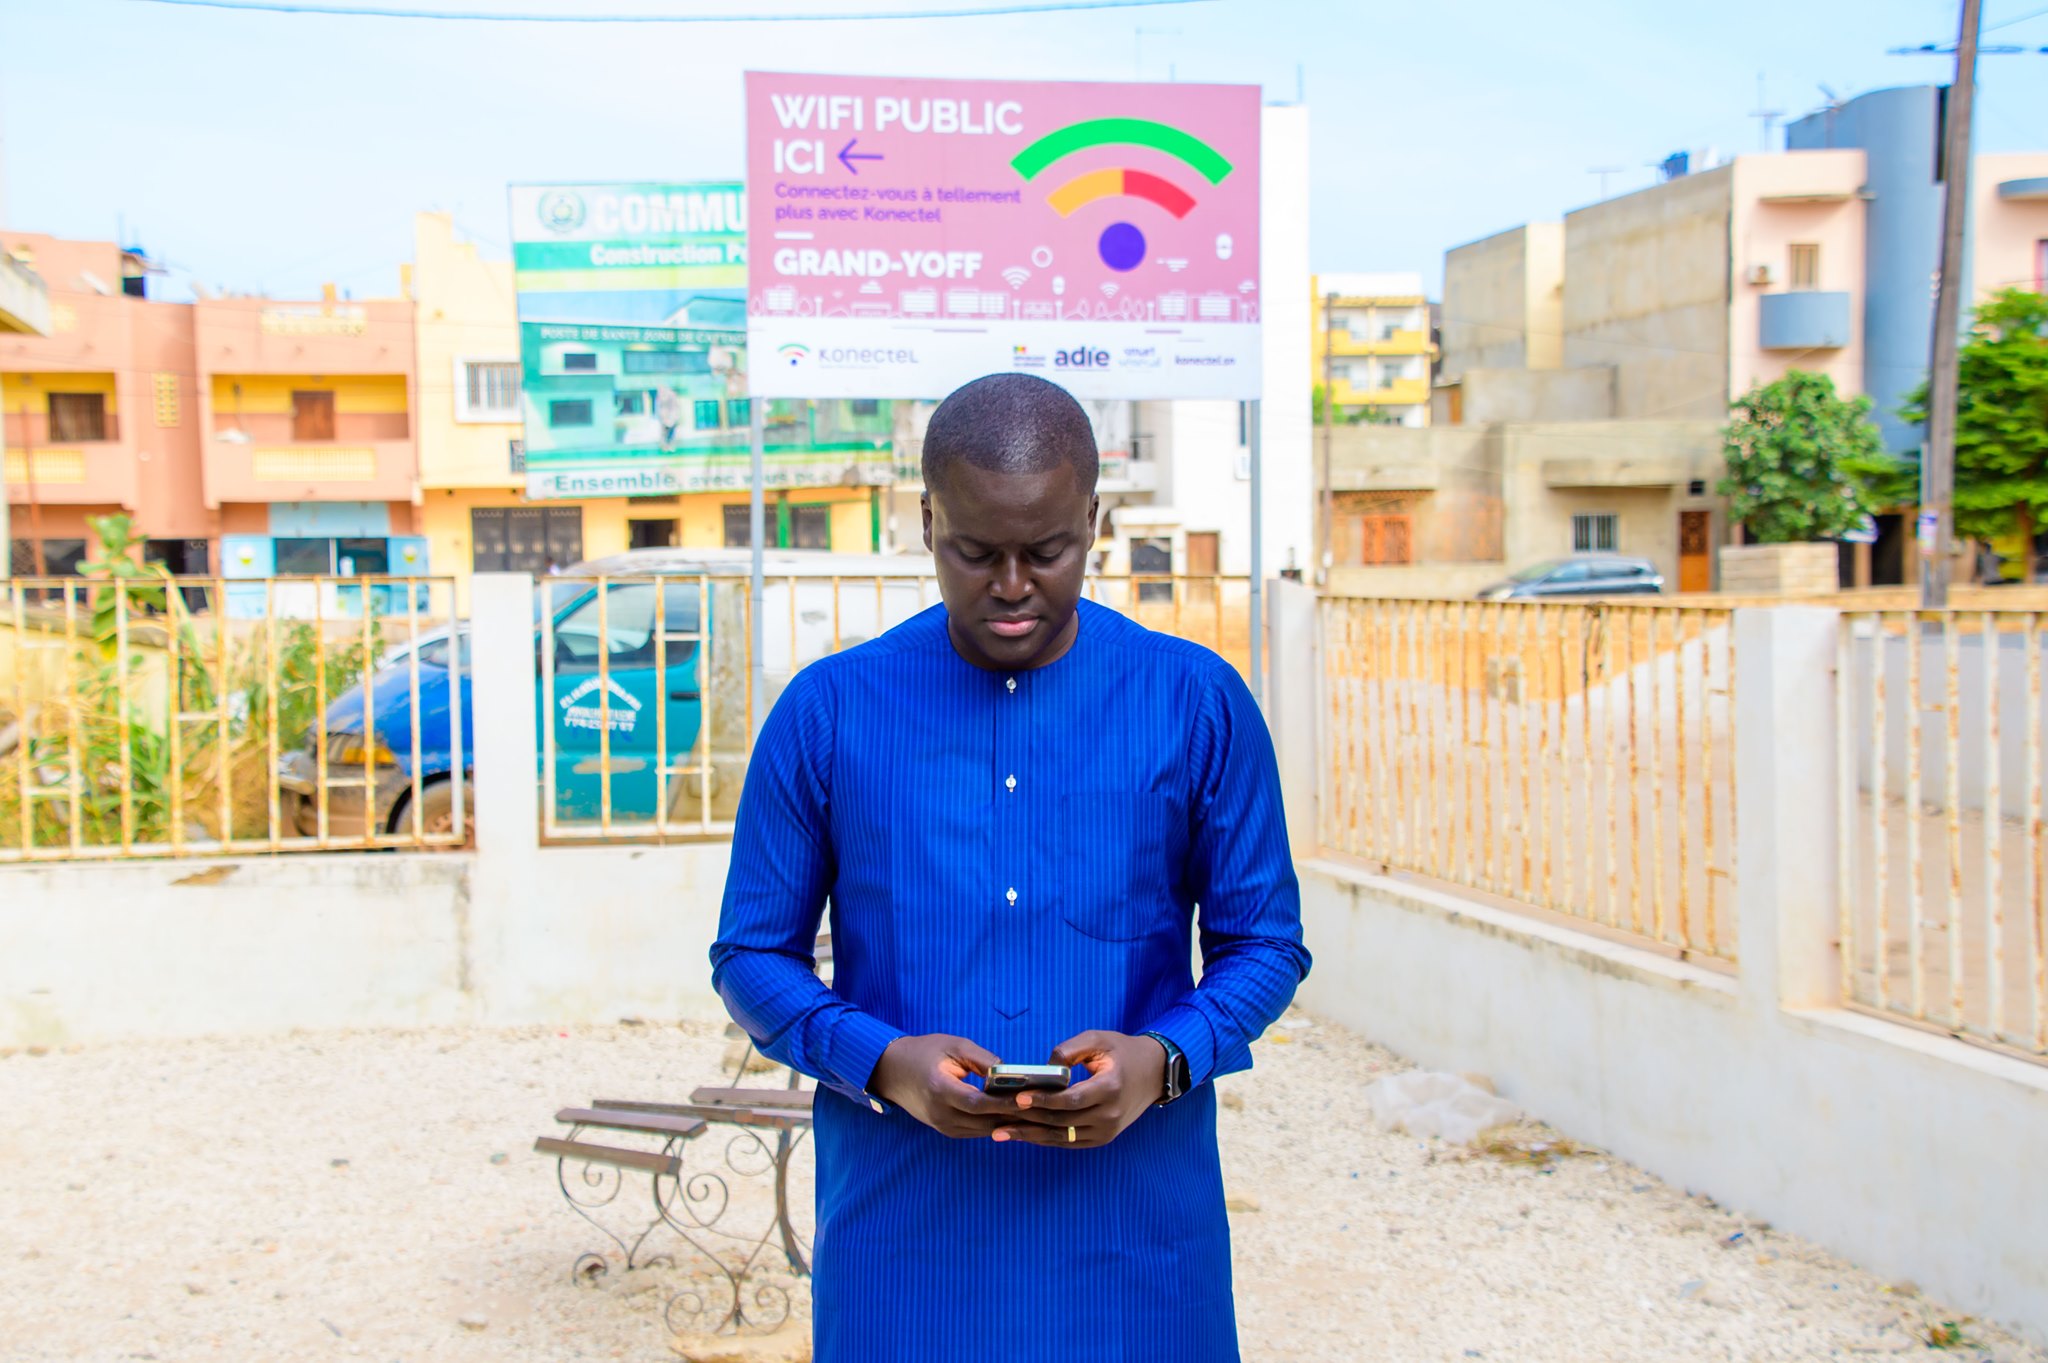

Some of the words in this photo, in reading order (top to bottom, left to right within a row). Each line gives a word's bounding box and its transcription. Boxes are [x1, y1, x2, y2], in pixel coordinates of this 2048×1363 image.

[770, 94, 864, 131] WIFI
[875, 97, 1024, 135] PUBLIC
[773, 139, 825, 174] ICI
[774, 182, 917, 202] Connectez-vous
[922, 187, 933, 202] à
[937, 187, 1021, 204] tellement
[597, 192, 746, 233] COMMU
[775, 205, 813, 222] plus
[817, 209, 858, 221] avec
[863, 206, 942, 223] Konectel
[590, 242, 722, 266] Construction
[773, 248, 983, 278] GRAND-YOFF
[1054, 345, 1111, 367] adie
[690, 475, 736, 488] avec
